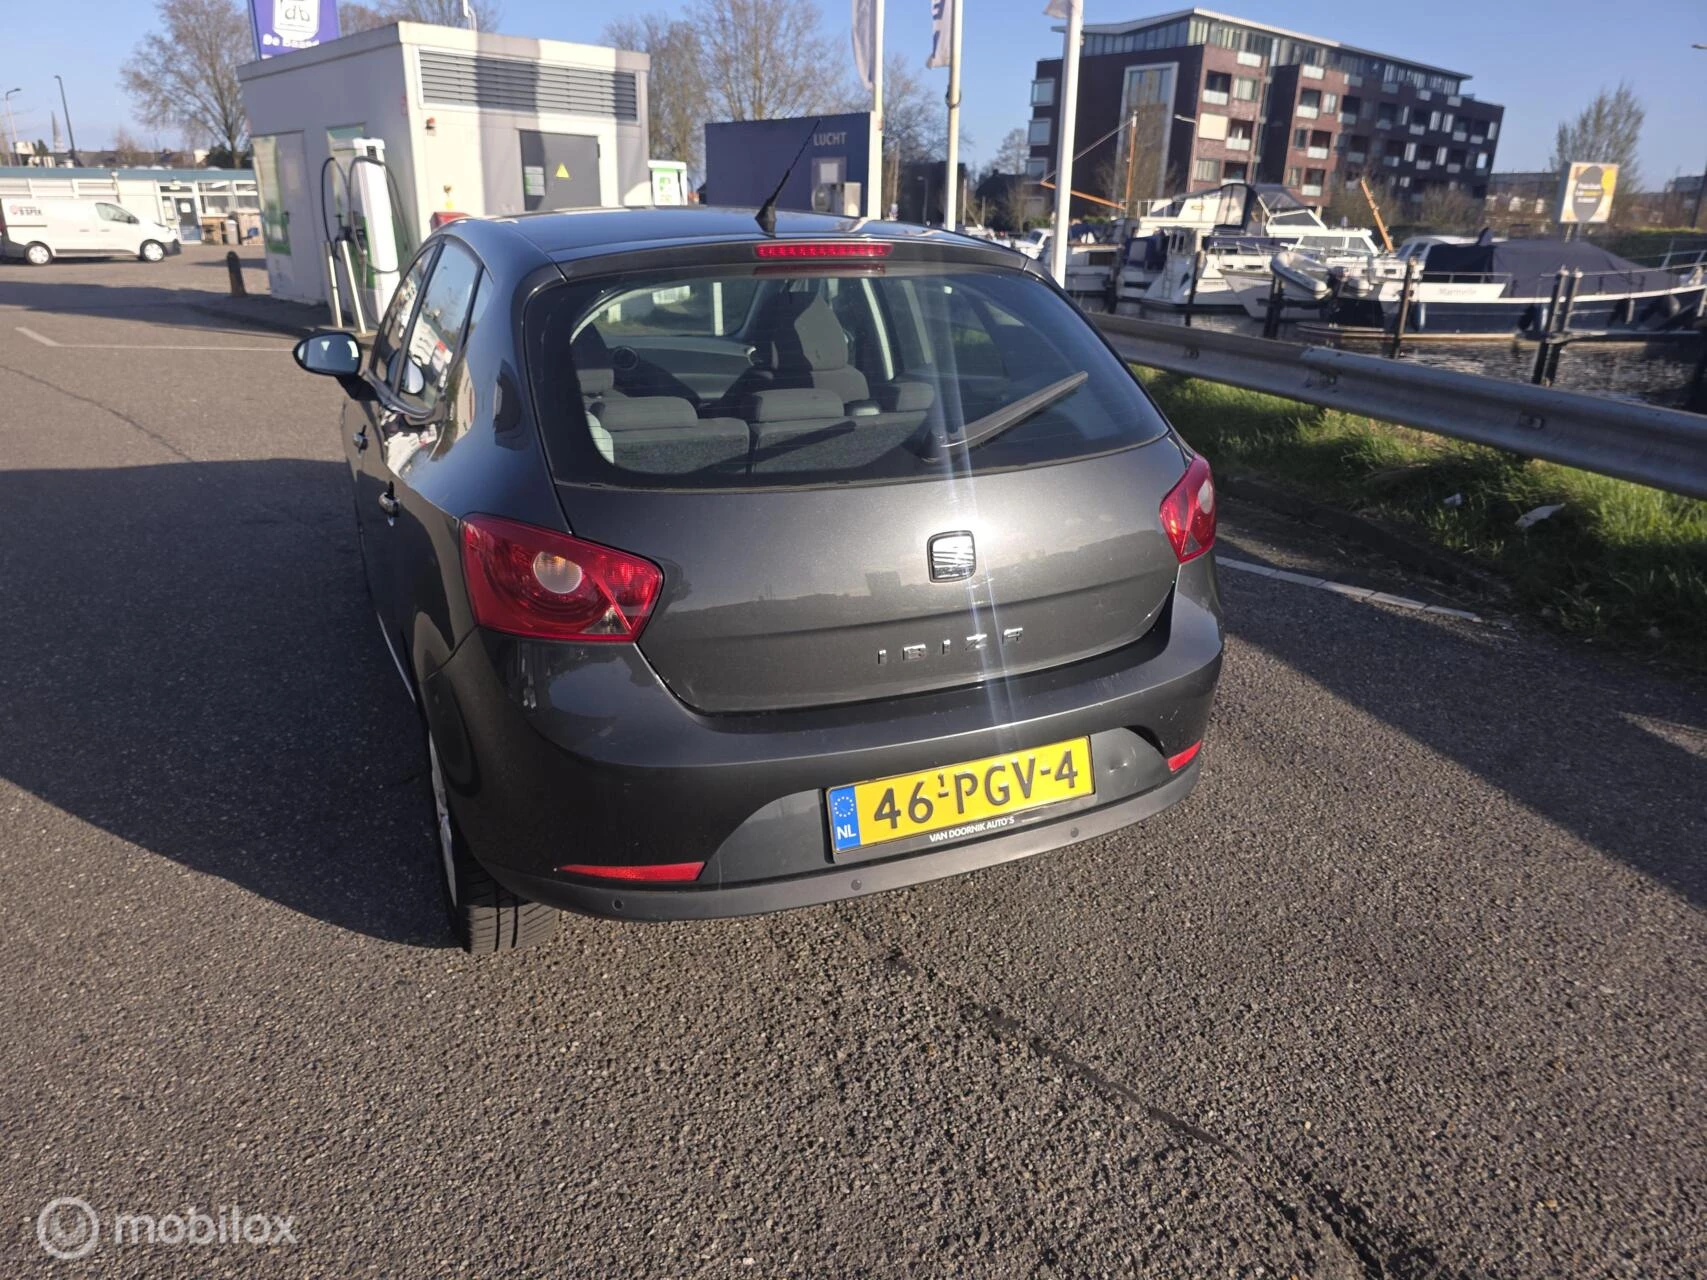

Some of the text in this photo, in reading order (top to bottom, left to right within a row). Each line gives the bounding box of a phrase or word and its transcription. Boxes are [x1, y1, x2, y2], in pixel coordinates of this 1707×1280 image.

[813, 131, 847, 147] LUCHT
[878, 627, 1024, 665] IBIZA
[874, 749, 1079, 830] 46-PGV-4
[837, 824, 857, 840] NL
[929, 816, 1015, 843] VAN DOORNIK AUTO'S
